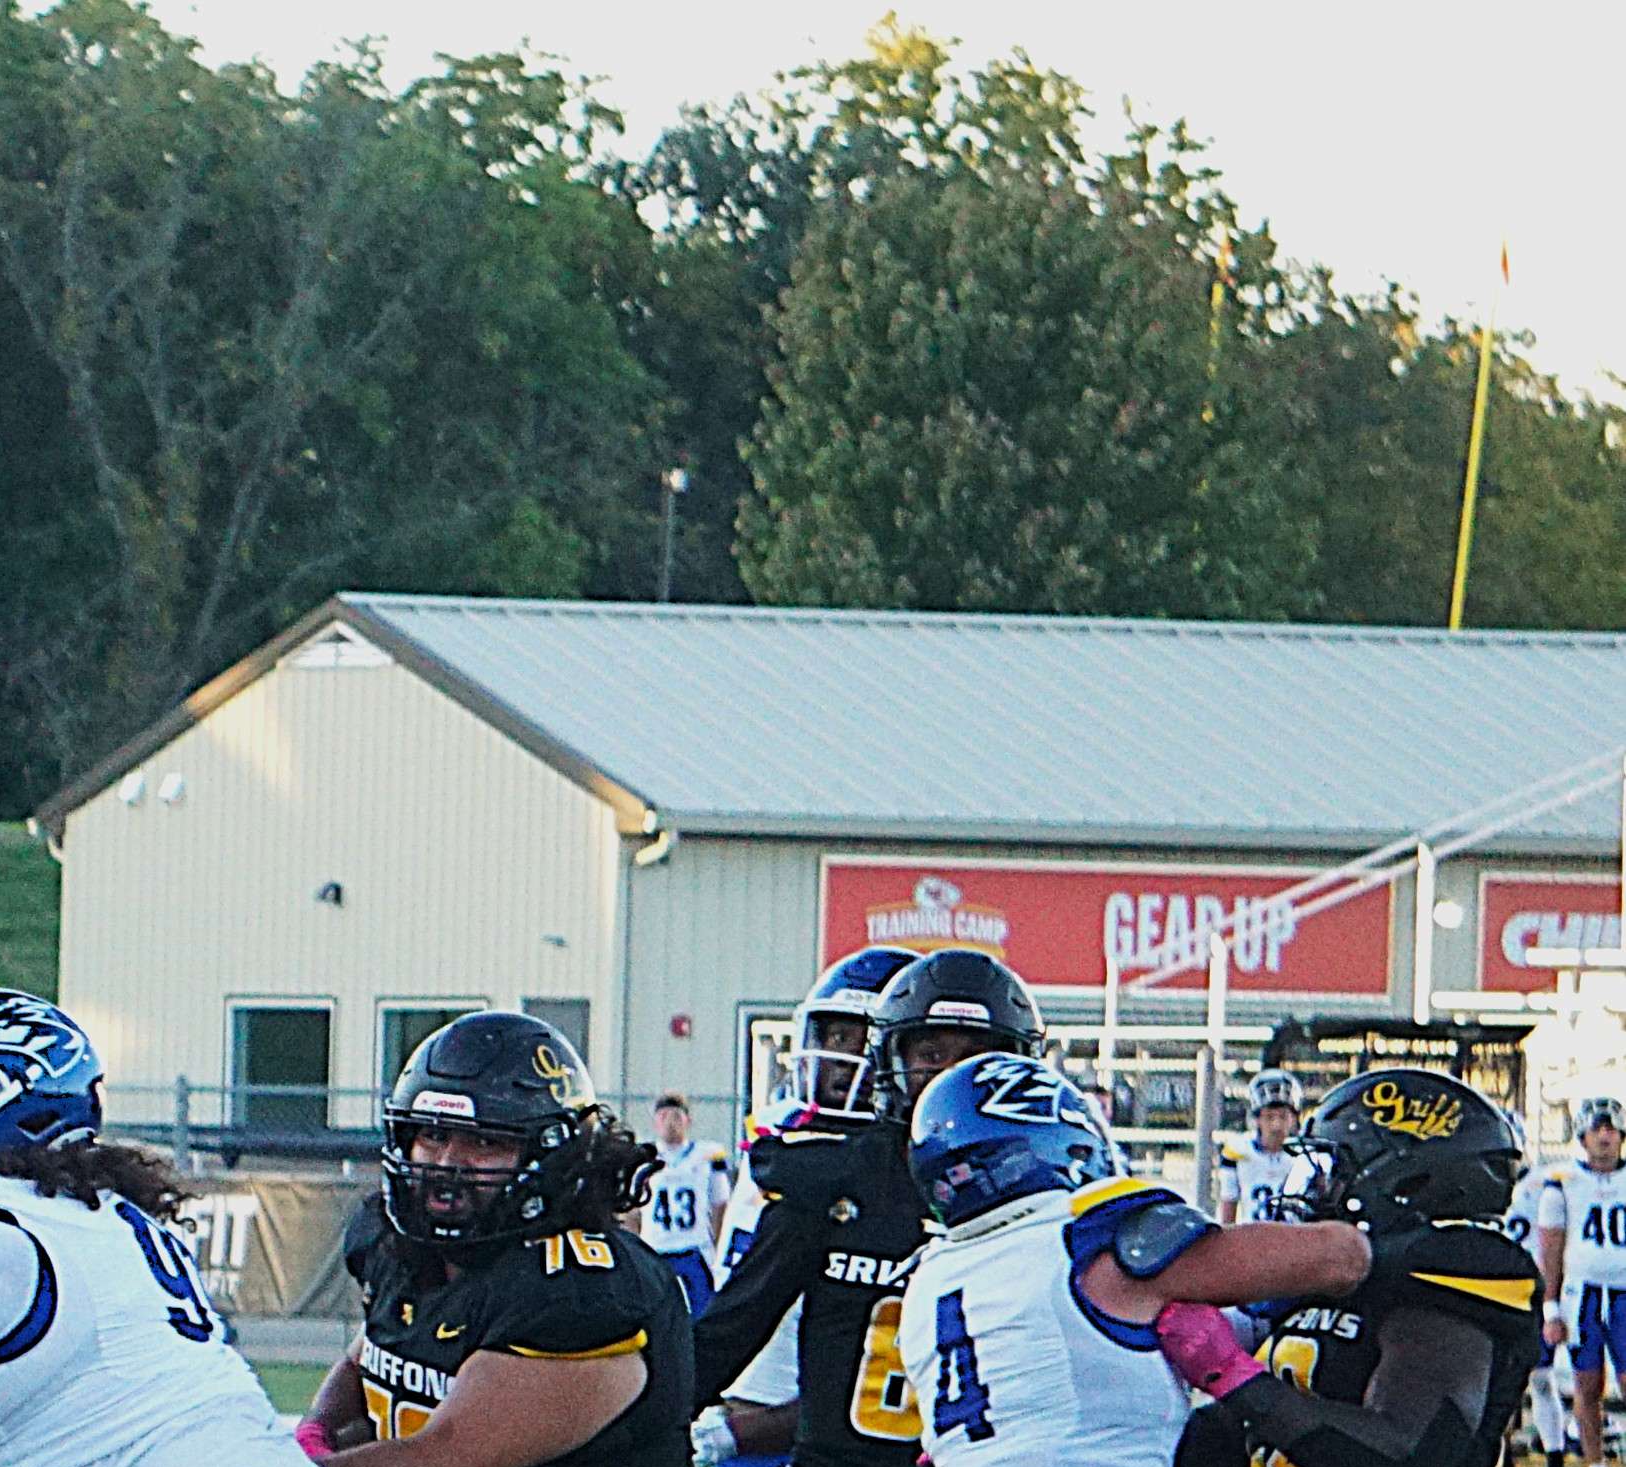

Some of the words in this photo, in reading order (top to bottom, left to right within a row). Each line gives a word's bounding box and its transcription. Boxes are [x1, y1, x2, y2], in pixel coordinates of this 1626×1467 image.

[954, 909, 1010, 945] CAMP
[1104, 892, 1226, 970] GEAR
[1233, 895, 1298, 974] UP
[652, 1187, 697, 1232] 43
[1582, 1204, 1626, 1248] 40
[114, 1201, 215, 1343] 9
[524, 1229, 615, 1276] 76
[359, 1336, 458, 1402] RIFFON
[933, 1285, 996, 1444] 4
